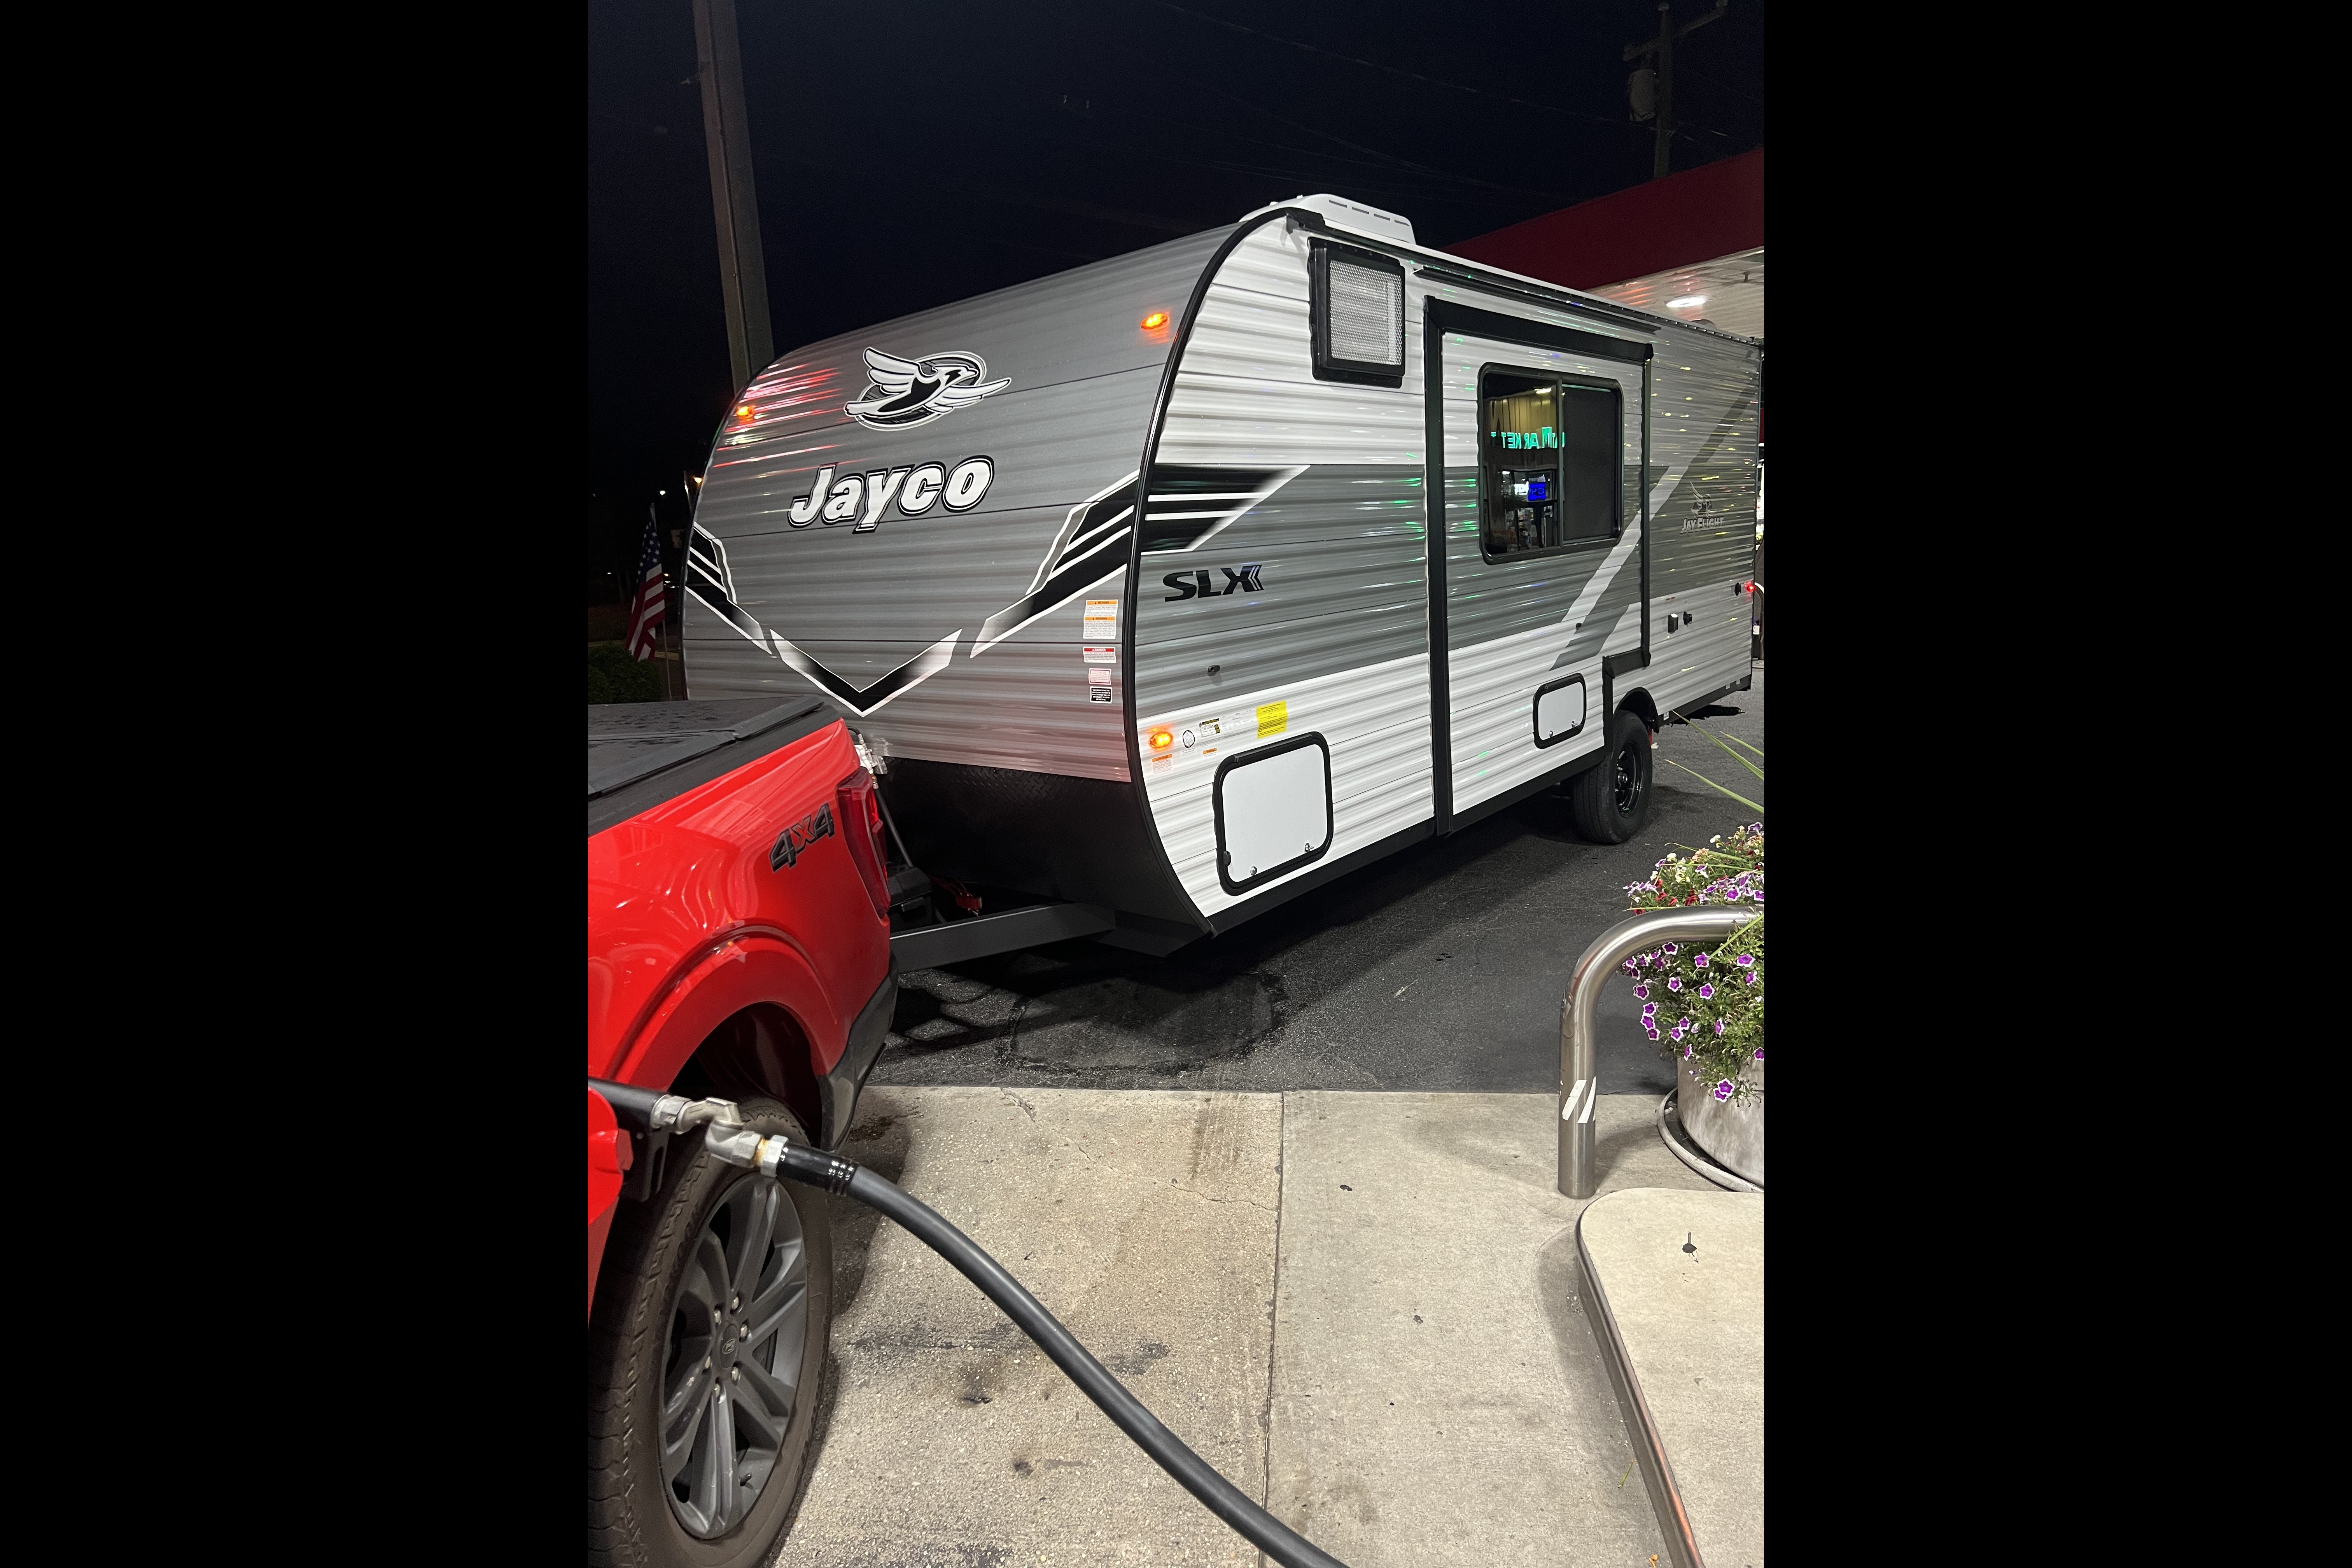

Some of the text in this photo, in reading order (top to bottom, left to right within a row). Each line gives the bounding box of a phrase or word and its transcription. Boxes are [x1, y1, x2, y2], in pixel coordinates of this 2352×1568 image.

[788, 455, 994, 534] Jayco
[1679, 516, 1724, 535] JAY FLIGHT
[1163, 565, 1264, 602] SLX
